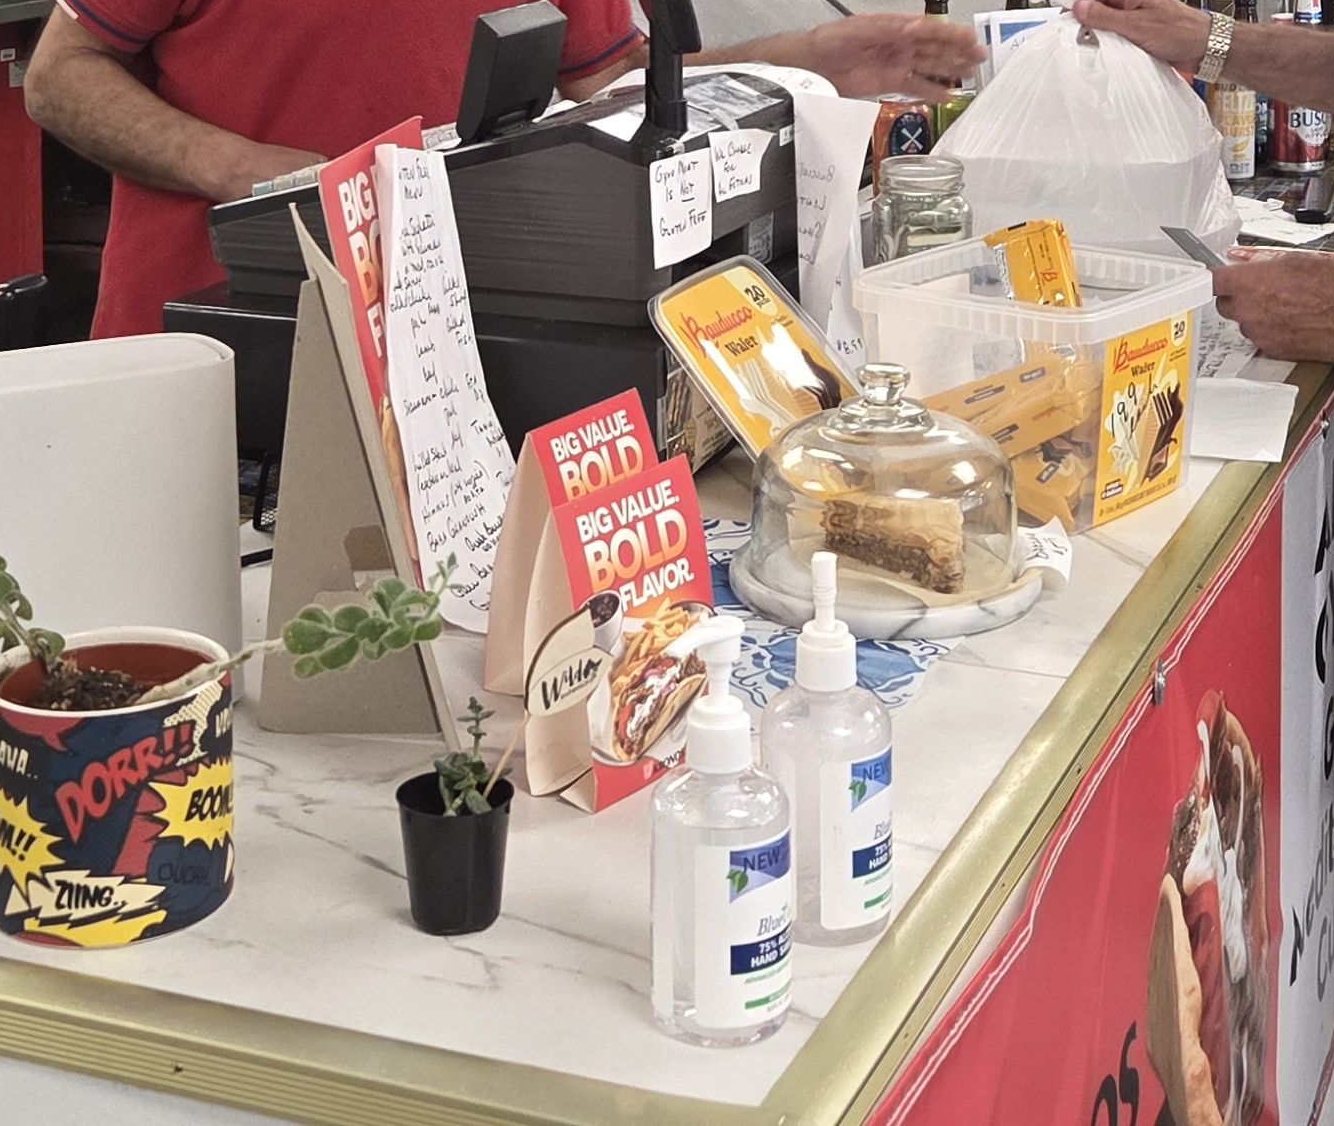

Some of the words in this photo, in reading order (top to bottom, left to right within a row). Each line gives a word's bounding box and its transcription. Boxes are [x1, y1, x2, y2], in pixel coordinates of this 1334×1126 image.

[338, 171, 377, 233] BIG
[745, 285, 766, 302] 20
[678, 305, 754, 359] Bauducco
[725, 335, 758, 357] Wafer
[1173, 320, 1185, 336] 20
[1113, 336, 1168, 374] Bauducco
[1131, 361, 1156, 377] Wafer
[550, 430, 583, 463] BIG
[579, 409, 635, 448] VALUE.
[558, 436, 644, 502] BOLD
[576, 503, 614, 544] BIG
[611, 478, 681, 527] VALUE.
[583, 508, 688, 595] BOLD
[621, 562, 695, 612] FLAVOR.
[55, 720, 196, 844] DORR!!
[743, 849, 780, 872] NEW
[751, 951, 778, 969] HAND
